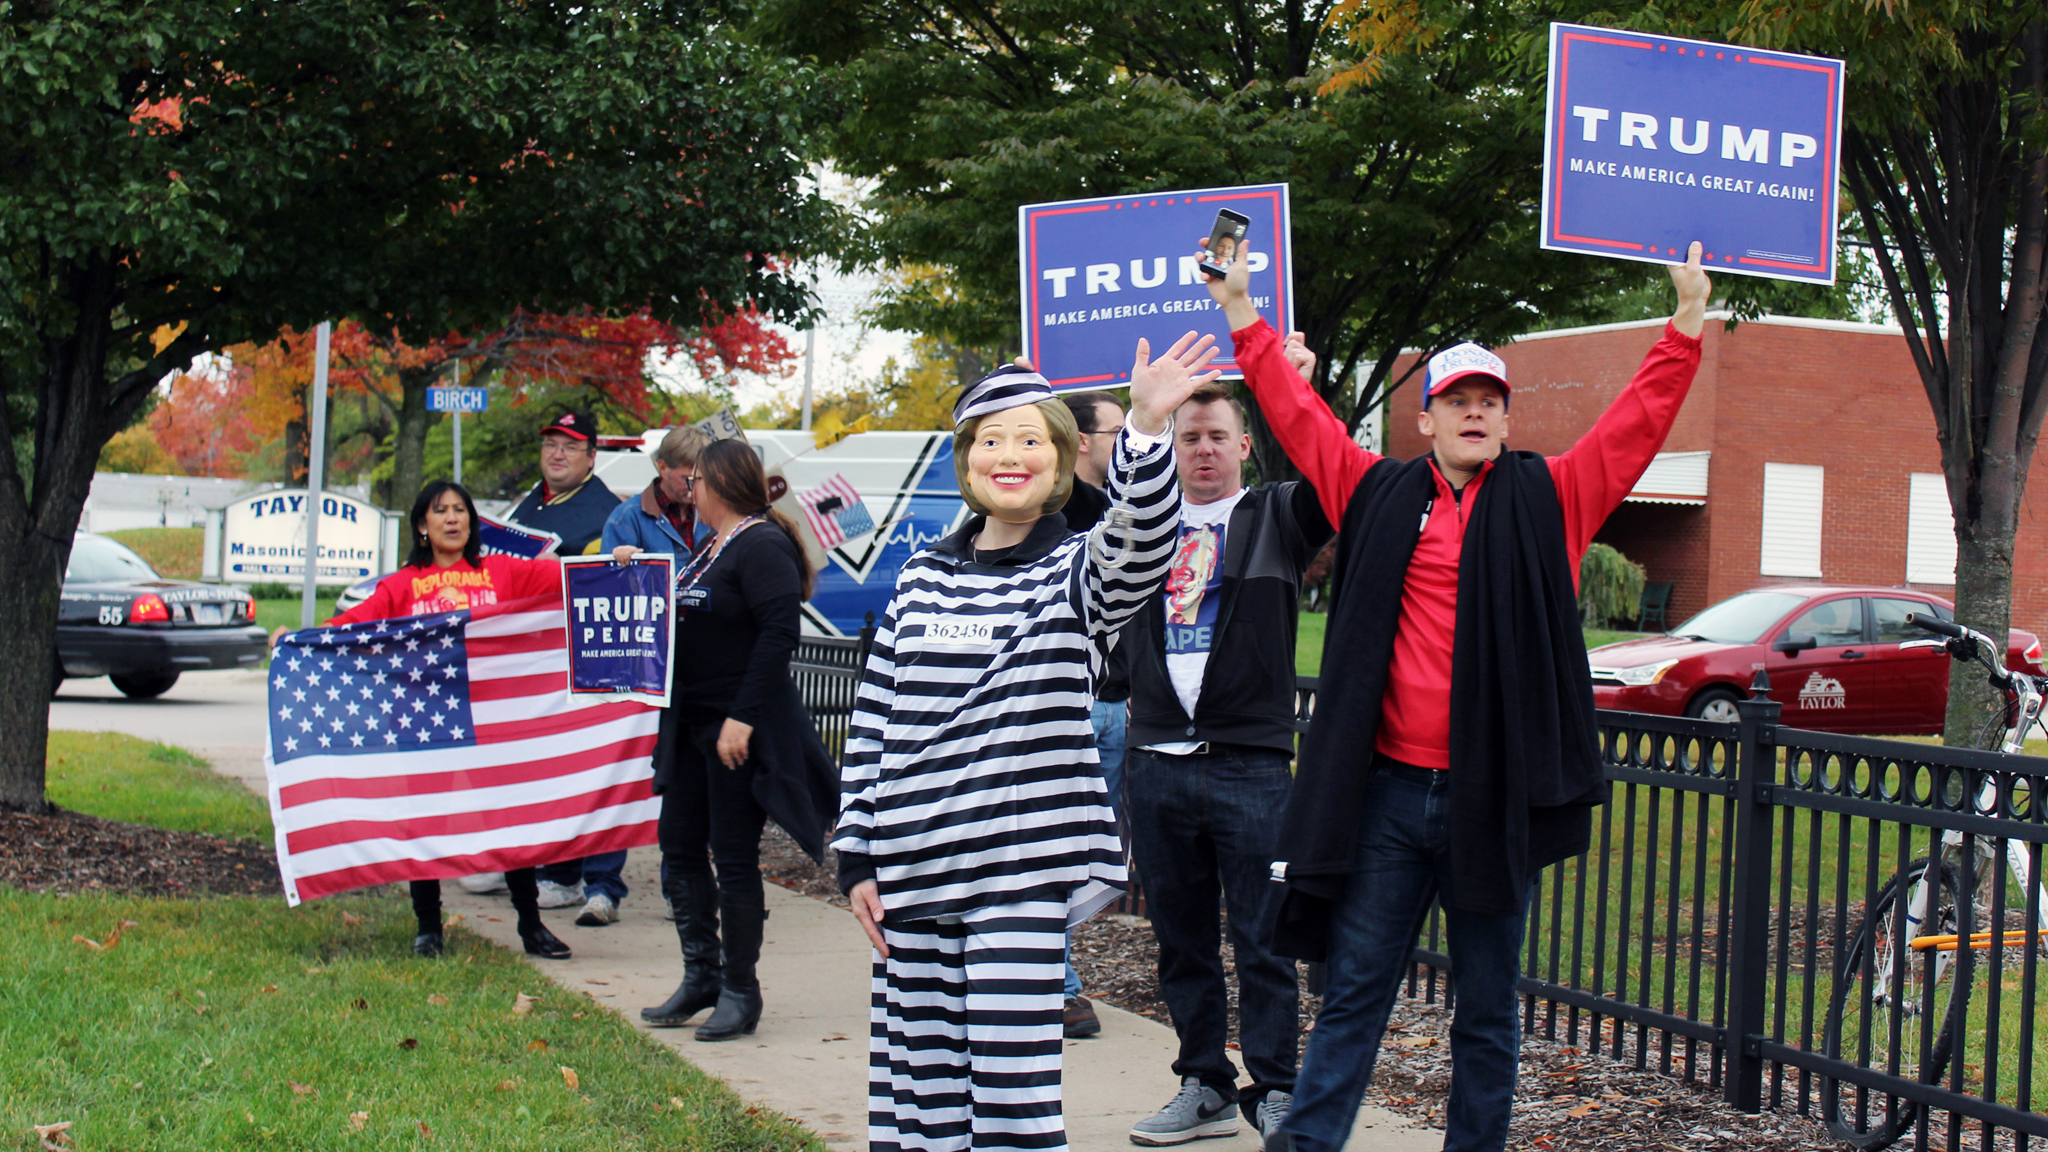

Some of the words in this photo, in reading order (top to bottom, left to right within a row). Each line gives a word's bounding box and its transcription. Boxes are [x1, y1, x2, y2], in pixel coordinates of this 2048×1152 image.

[1572, 105, 1818, 168] TRUMP
[1570, 158, 1617, 177] MAKE
[1621, 164, 1697, 187] AMERICA
[1701, 174, 1754, 194] GREAT
[1757, 182, 1815, 202] AGAIN!
[1044, 309, 1087, 327] MAKE
[1090, 302, 1159, 322] AMERICA
[1162, 298, 1212, 314] GREAT
[434, 391, 482, 409] BIRCH
[717, 409, 742, 439] NOT
[250, 496, 358, 524] TAYOR
[231, 542, 307, 558] Masonic
[317, 545, 374, 560] Center
[161, 588, 210, 603] TAYLOR
[411, 568, 494, 600] DEPLORABLE
[98, 605, 123, 626] 55
[573, 595, 666, 623] TRUMP
[583, 626, 656, 644] PENCE
[928, 622, 990, 639] 362436
[1164, 626, 1211, 651] APE
[581, 650, 599, 658] MAKE
[600, 649, 625, 658] AMERICA
[625, 649, 641, 657] GREAT
[1799, 696, 1846, 710] TAYLOR
